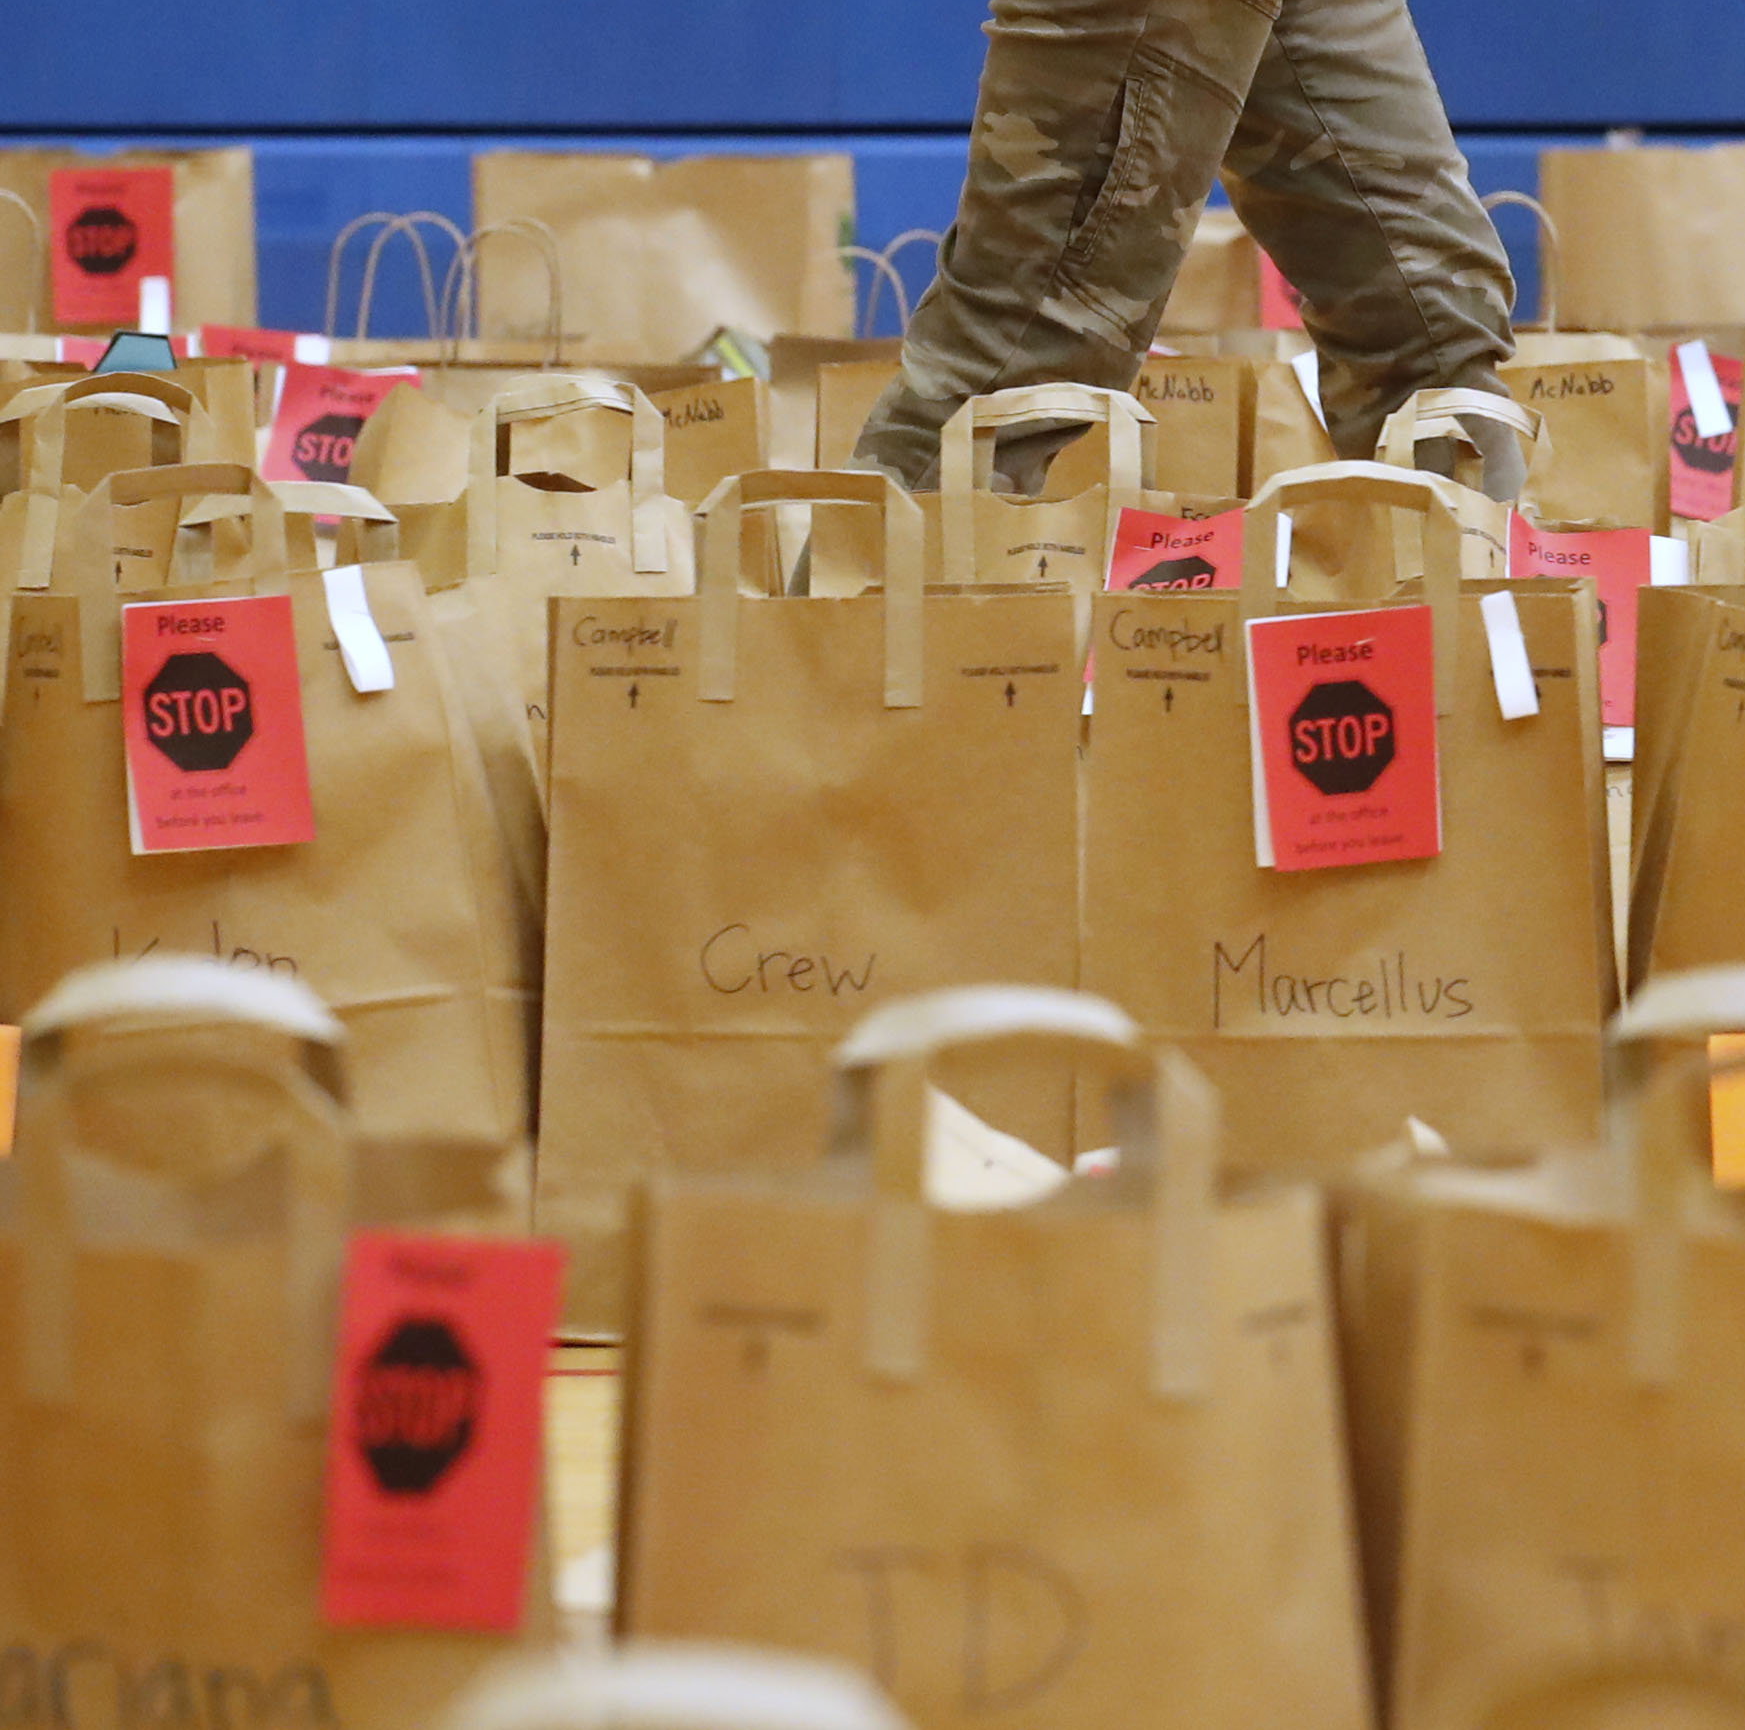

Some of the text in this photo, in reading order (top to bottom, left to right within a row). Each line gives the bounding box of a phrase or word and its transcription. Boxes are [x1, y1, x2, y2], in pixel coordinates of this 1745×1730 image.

[1137, 373, 1215, 404] McNabb
[1529, 373, 1615, 401] McNabb
[298, 432, 355, 466] STO
[1150, 529, 1215, 552] Please
[1528, 541, 1592, 568] Please
[155, 611, 226, 638] Please
[1296, 636, 1375, 667] Please
[149, 683, 248, 738] STOP
[1293, 710, 1391, 766] STOP
[699, 921, 878, 998] Crew
[1214, 932, 1476, 1030] Marcellus
